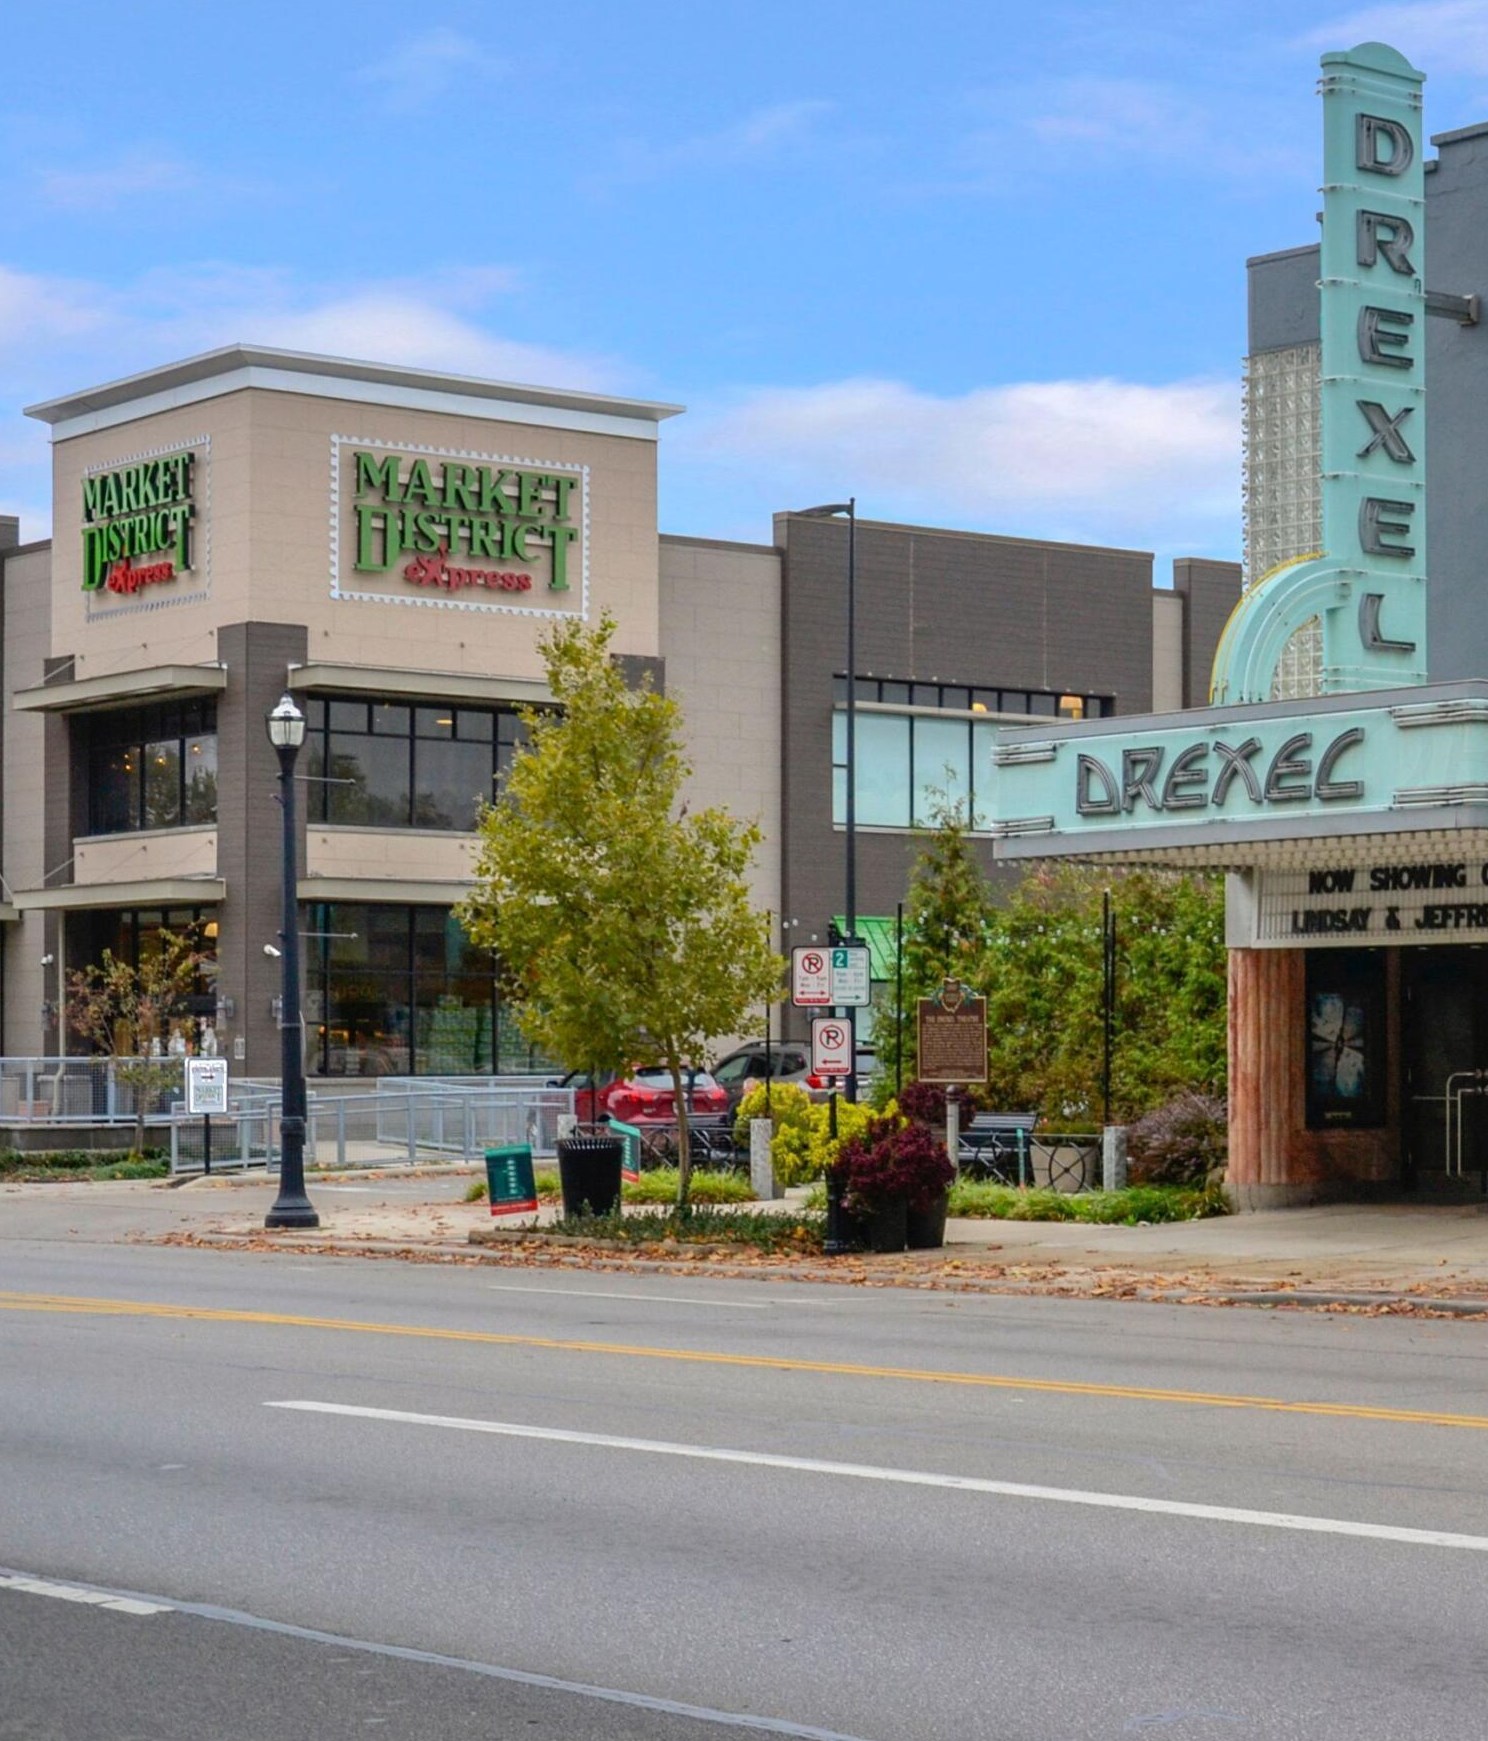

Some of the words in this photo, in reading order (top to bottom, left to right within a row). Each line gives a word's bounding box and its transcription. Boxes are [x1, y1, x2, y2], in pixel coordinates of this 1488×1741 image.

[1355, 112, 1417, 654] DREXEL
[81, 451, 195, 523] MARKET
[353, 451, 578, 521] MARKET
[81, 503, 195, 591] DISTRICT
[353, 503, 578, 591] DISTRICT
[1076, 727, 1364, 816] DREXEL
[1309, 868, 1355, 894] NOW
[1370, 863, 1467, 892] SHOWING
[1292, 906, 1371, 933] LINDSAY
[1385, 906, 1401, 930] &
[835, 952, 845, 967] 2
